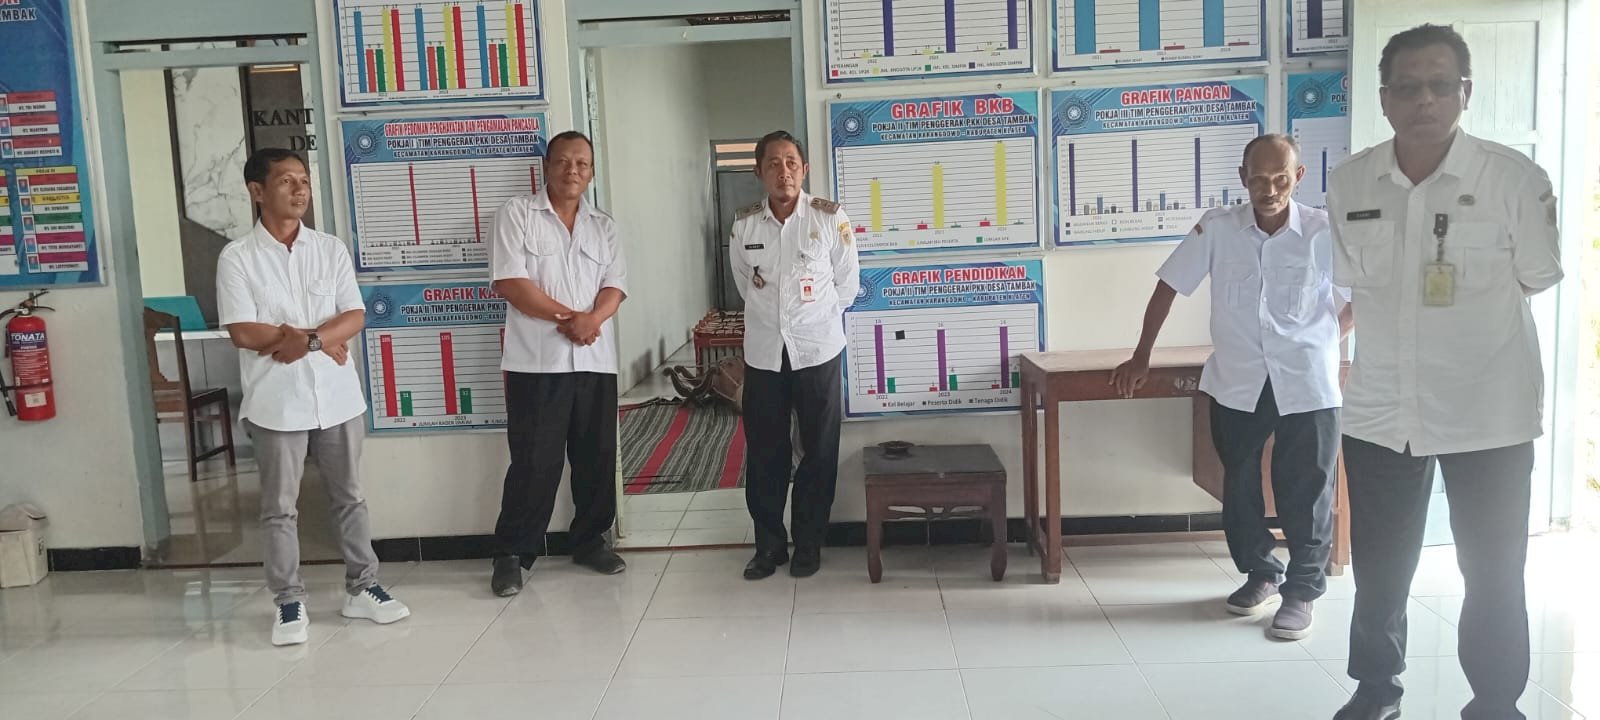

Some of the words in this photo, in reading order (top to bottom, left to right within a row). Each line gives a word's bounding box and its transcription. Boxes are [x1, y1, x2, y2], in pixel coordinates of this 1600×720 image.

[0, 8, 36, 22] MBAK
[1122, 89, 1171, 105] GRAFIK
[1174, 86, 1231, 102] PANGAN
[891, 101, 964, 119] GRAFIK
[975, 98, 1014, 115] BKB
[1096, 110, 1118, 120] POKJA
[1120, 110, 1128, 118] III
[1130, 109, 1143, 118] TIM
[1145, 105, 1187, 116] PENGGERAK
[1189, 104, 1204, 113] PKK
[1206, 103, 1223, 112] DESA
[1225, 101, 1256, 111] TAMBAK
[254, 108, 314, 126] KANT
[872, 121, 896, 132] POKJA
[897, 121, 903, 130] II
[905, 120, 918, 130] TIM
[921, 118, 963, 129] PENGGERAK
[966, 117, 982, 127] PKK
[983, 116, 1001, 126] DESA
[1002, 115, 1034, 124] TAMBAK
[1103, 120, 1139, 128] KECAMATAN
[1190, 115, 1224, 123] KABUPATEN
[1226, 113, 1249, 121] KLATEN
[385, 123, 403, 137] GRAFIK
[404, 122, 428, 136] PEDOMAN
[429, 120, 464, 135] PENGHAYATAN
[477, 119, 510, 133] PENGAMALAN
[511, 118, 539, 131] PANCASILA
[881, 132, 917, 141] KECAMATAN
[966, 128, 1001, 136] KABUPATEN
[1002, 126, 1026, 134] KLATEN
[289, 135, 317, 151] DE
[387, 138, 409, 149] POKJA
[418, 137, 430, 148] TIM
[433, 136, 474, 147] PENGGERAK
[475, 136, 490, 146] PKK
[491, 135, 508, 145] DESA
[509, 134, 539, 144] TAMBAK
[393, 150, 428, 158] KECAMATAN
[893, 269, 941, 285] GRAFIK
[945, 266, 1026, 282] PENDIDIKAN
[423, 288, 474, 302] GRAFIK
[883, 287, 906, 297] POKJA
[907, 287, 913, 295] II
[914, 286, 926, 295] TIM
[929, 284, 969, 295] PENGGERAK
[971, 283, 987, 293] PKK
[988, 282, 1005, 292] DESA
[1006, 281, 1035, 290] TAMBAK
[401, 305, 423, 315] POKJA
[424, 305, 430, 313] II
[431, 304, 443, 314] TIM
[446, 303, 485, 312] PENGGERAK
[487, 302, 501, 312] PKK
[889, 298, 925, 306] KECAMATAN
[11, 332, 45, 341] TONATA
